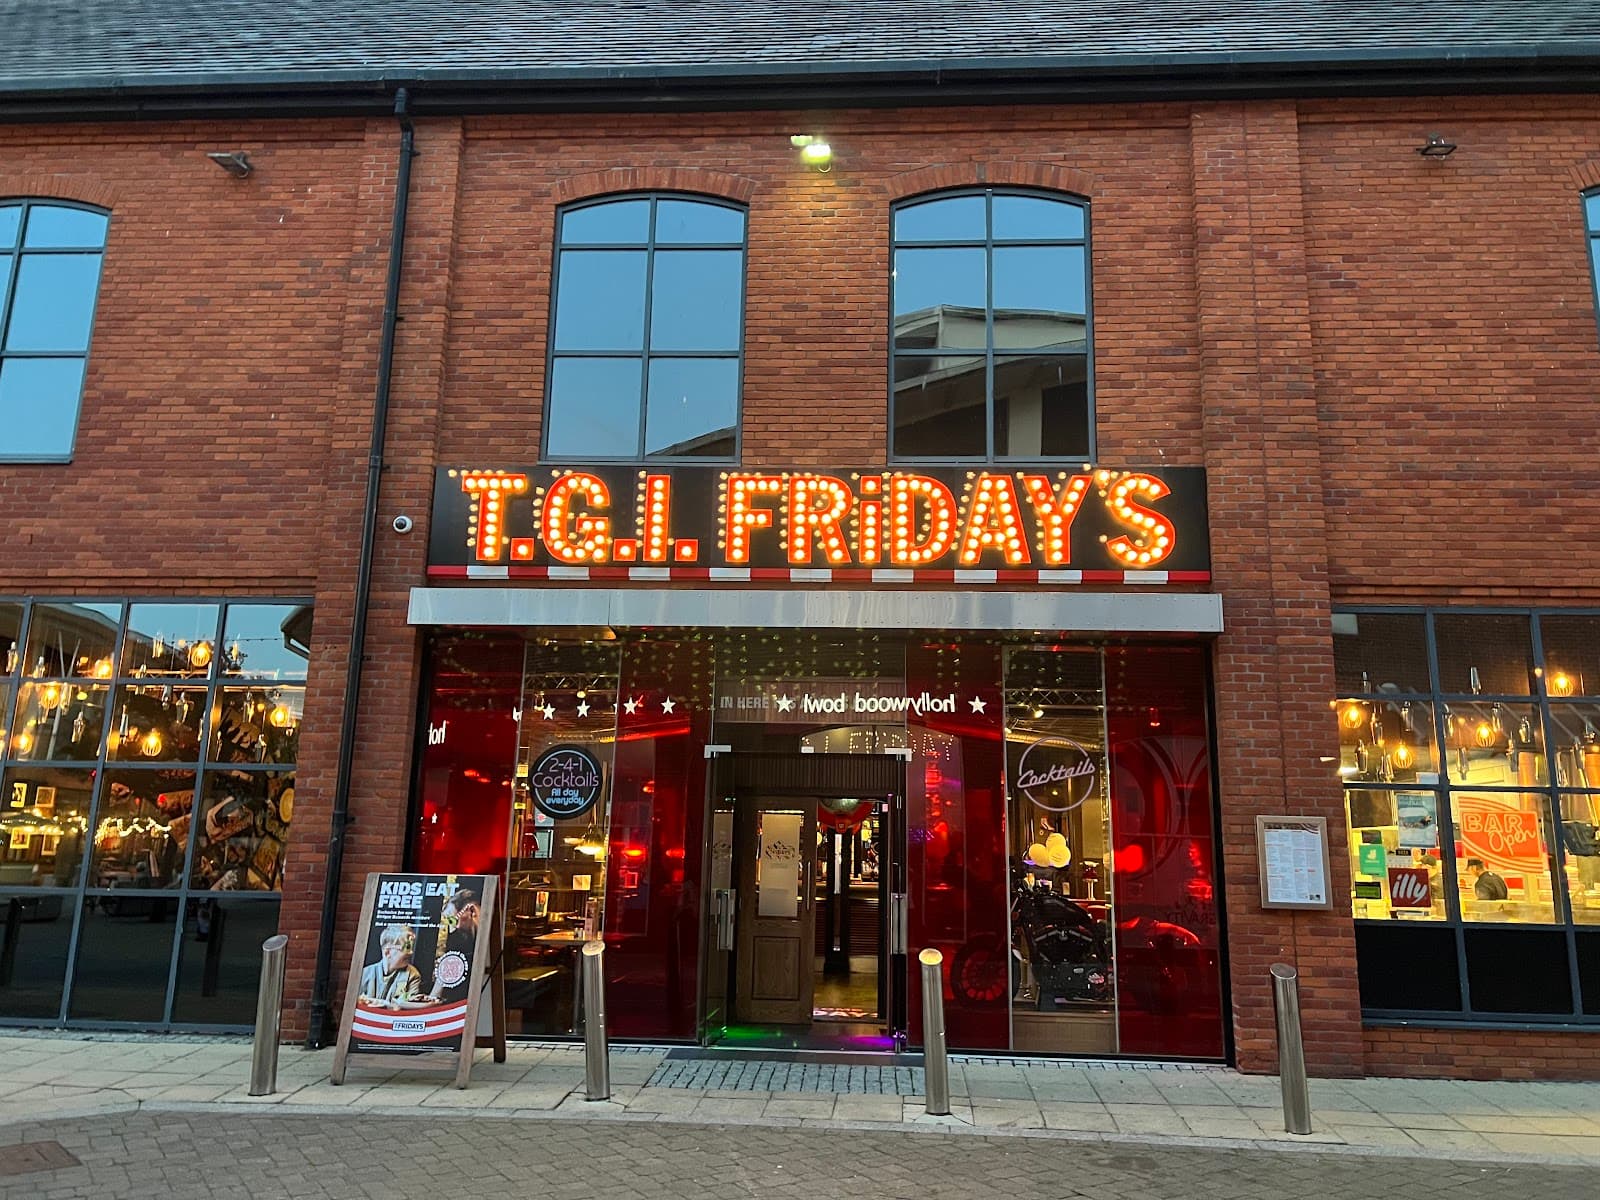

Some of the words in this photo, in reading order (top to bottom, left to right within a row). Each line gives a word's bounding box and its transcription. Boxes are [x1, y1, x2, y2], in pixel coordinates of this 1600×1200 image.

[462, 472, 698, 563] T.G.I.
[736, 696, 769, 709] HERE
[549, 757, 583, 773] 2-4-1
[1017, 757, 1096, 789] Cocktails
[532, 771, 599, 788] Cocktails
[551, 788, 562, 797] All
[562, 787, 579, 798] day
[545, 796, 584, 806] everyday
[1462, 813, 1523, 833] BAR
[1488, 827, 1536, 856] Open
[380, 881, 422, 895] KIDS
[425, 883, 459, 897] EAT
[1391, 873, 1428, 905] illy
[378, 895, 423, 909] FREE
